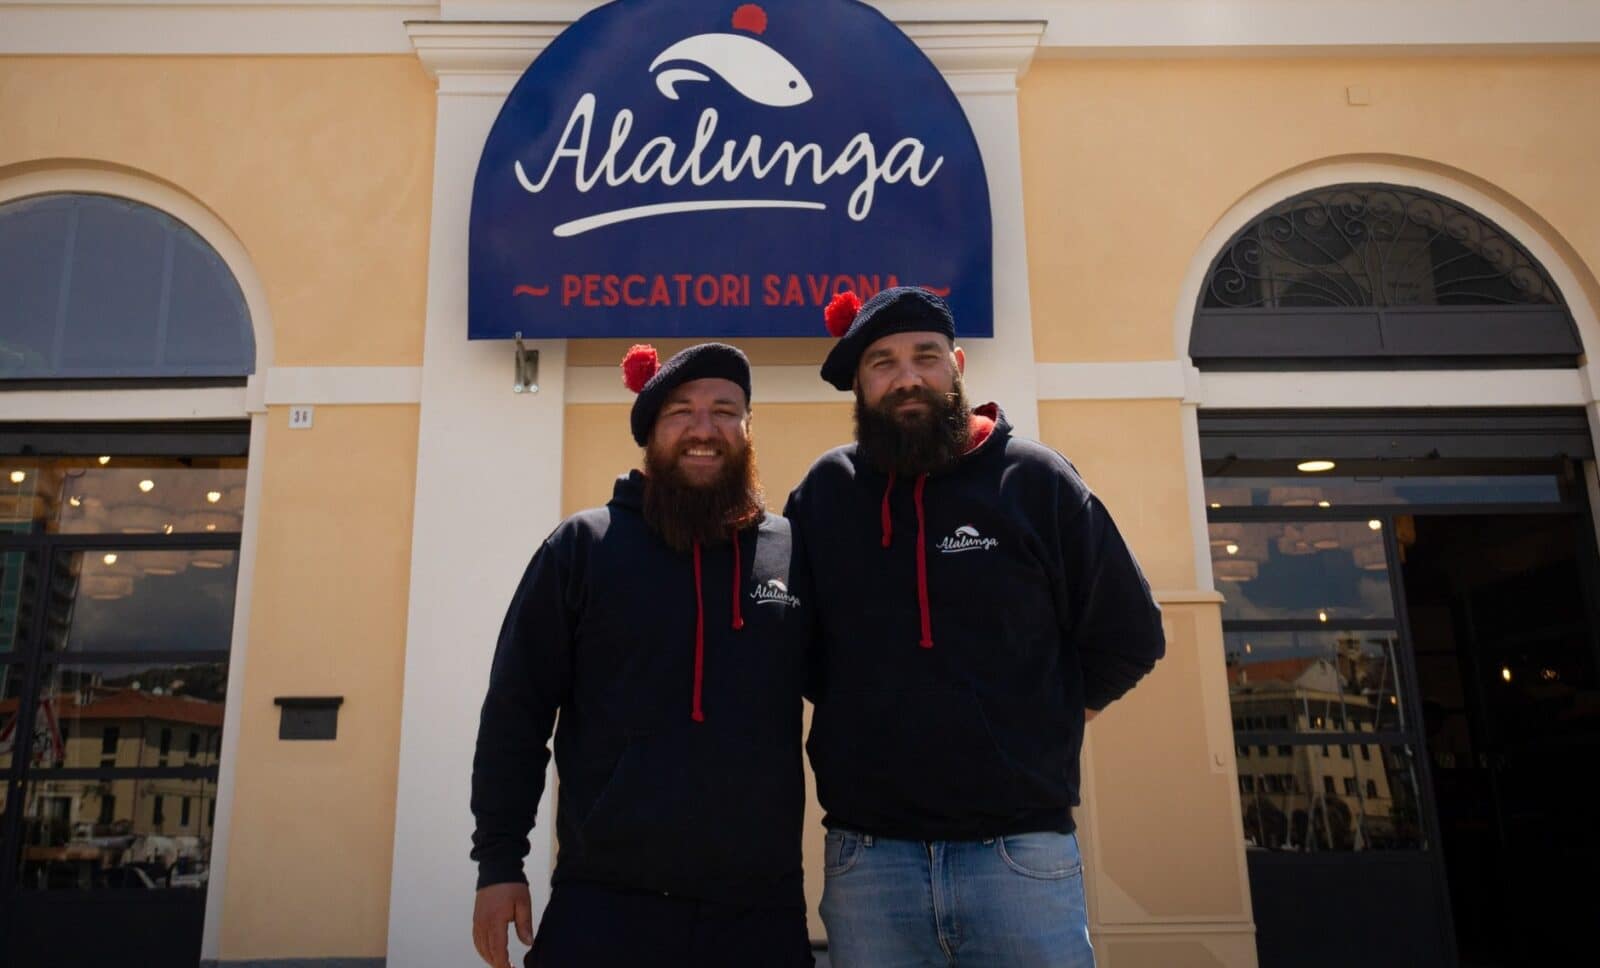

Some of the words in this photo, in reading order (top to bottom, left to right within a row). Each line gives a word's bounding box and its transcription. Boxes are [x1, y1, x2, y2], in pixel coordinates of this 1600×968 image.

[514, 92, 944, 222] Alalunga
[562, 273, 750, 307] PESCATORI
[936, 534, 999, 551] Alalunga
